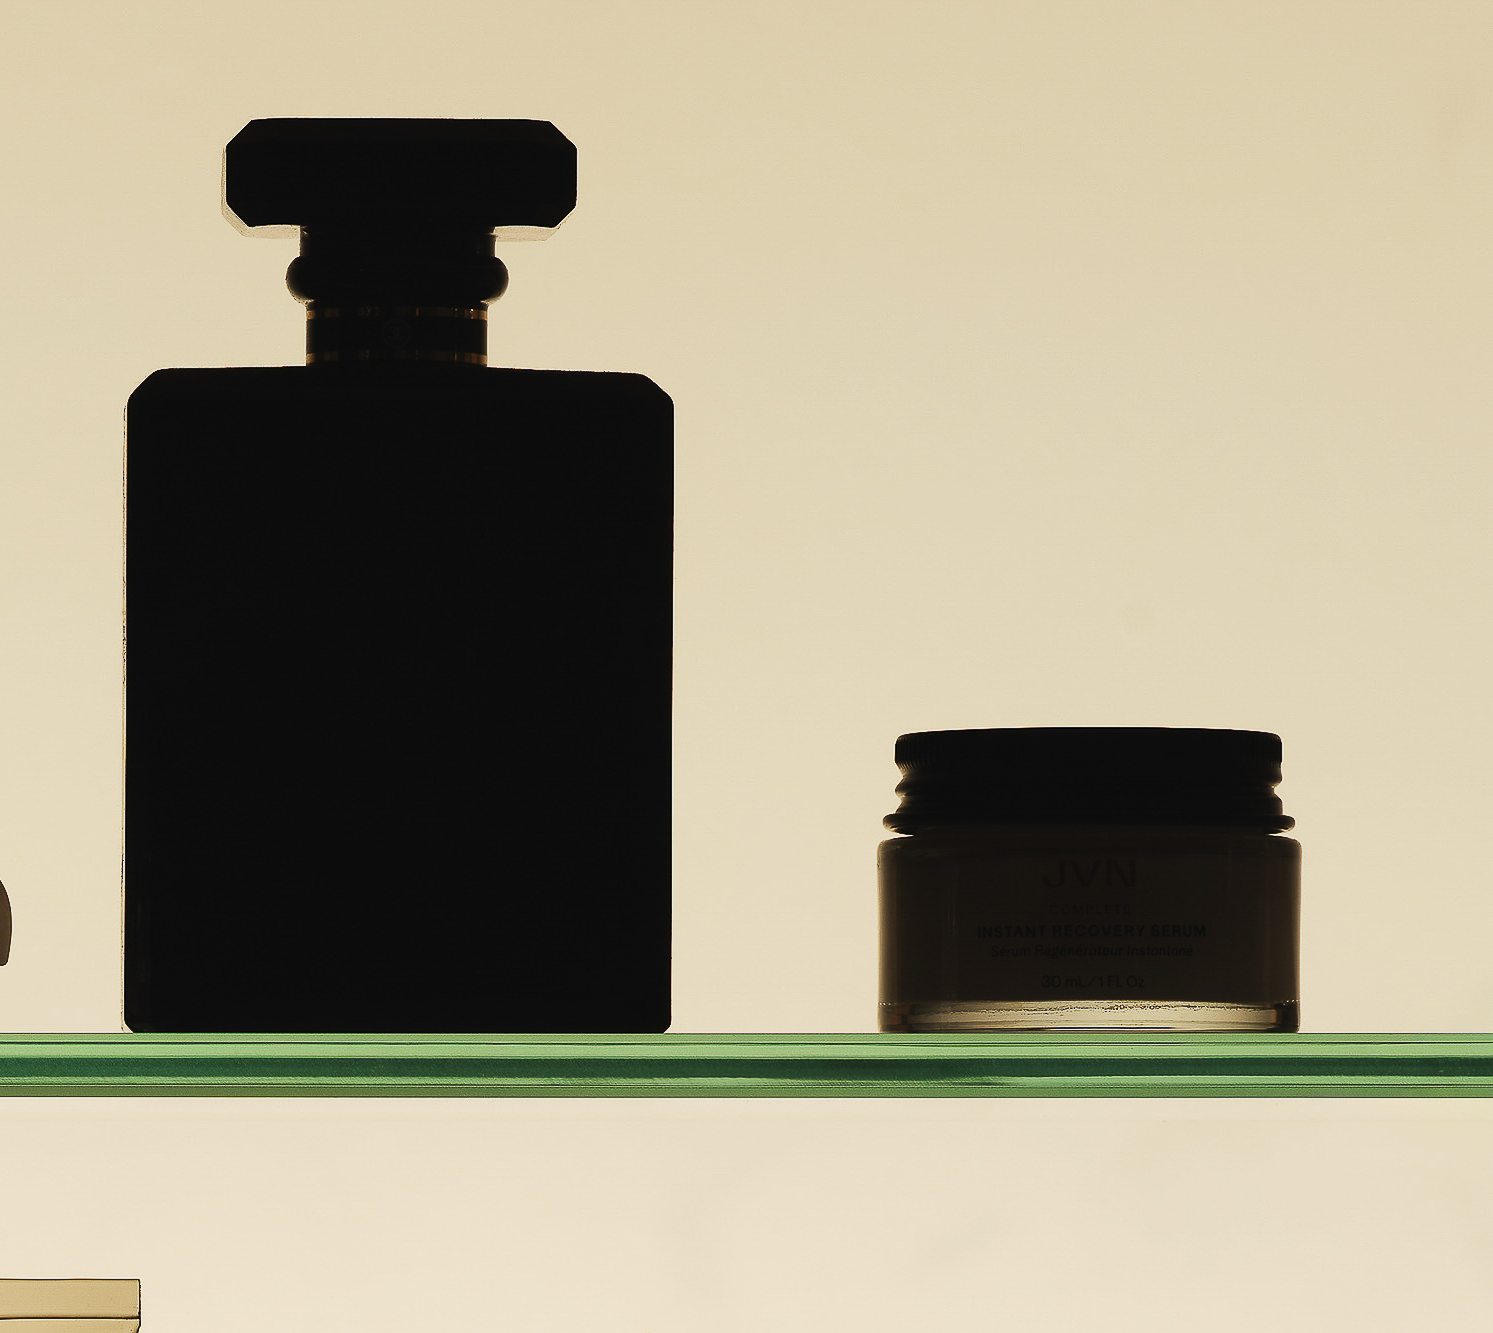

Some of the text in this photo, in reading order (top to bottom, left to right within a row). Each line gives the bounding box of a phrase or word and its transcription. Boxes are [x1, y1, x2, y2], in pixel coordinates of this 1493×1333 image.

[1043, 859, 1137, 888] JVN
[1050, 904, 1131, 915] COMPLETE
[977, 924, 1207, 938] INSTANT RECOVERY SERUM
[991, 944, 1032, 958] Sérum
[1041, 975, 1062, 989] 30
[1125, 975, 1145, 989] Oz
